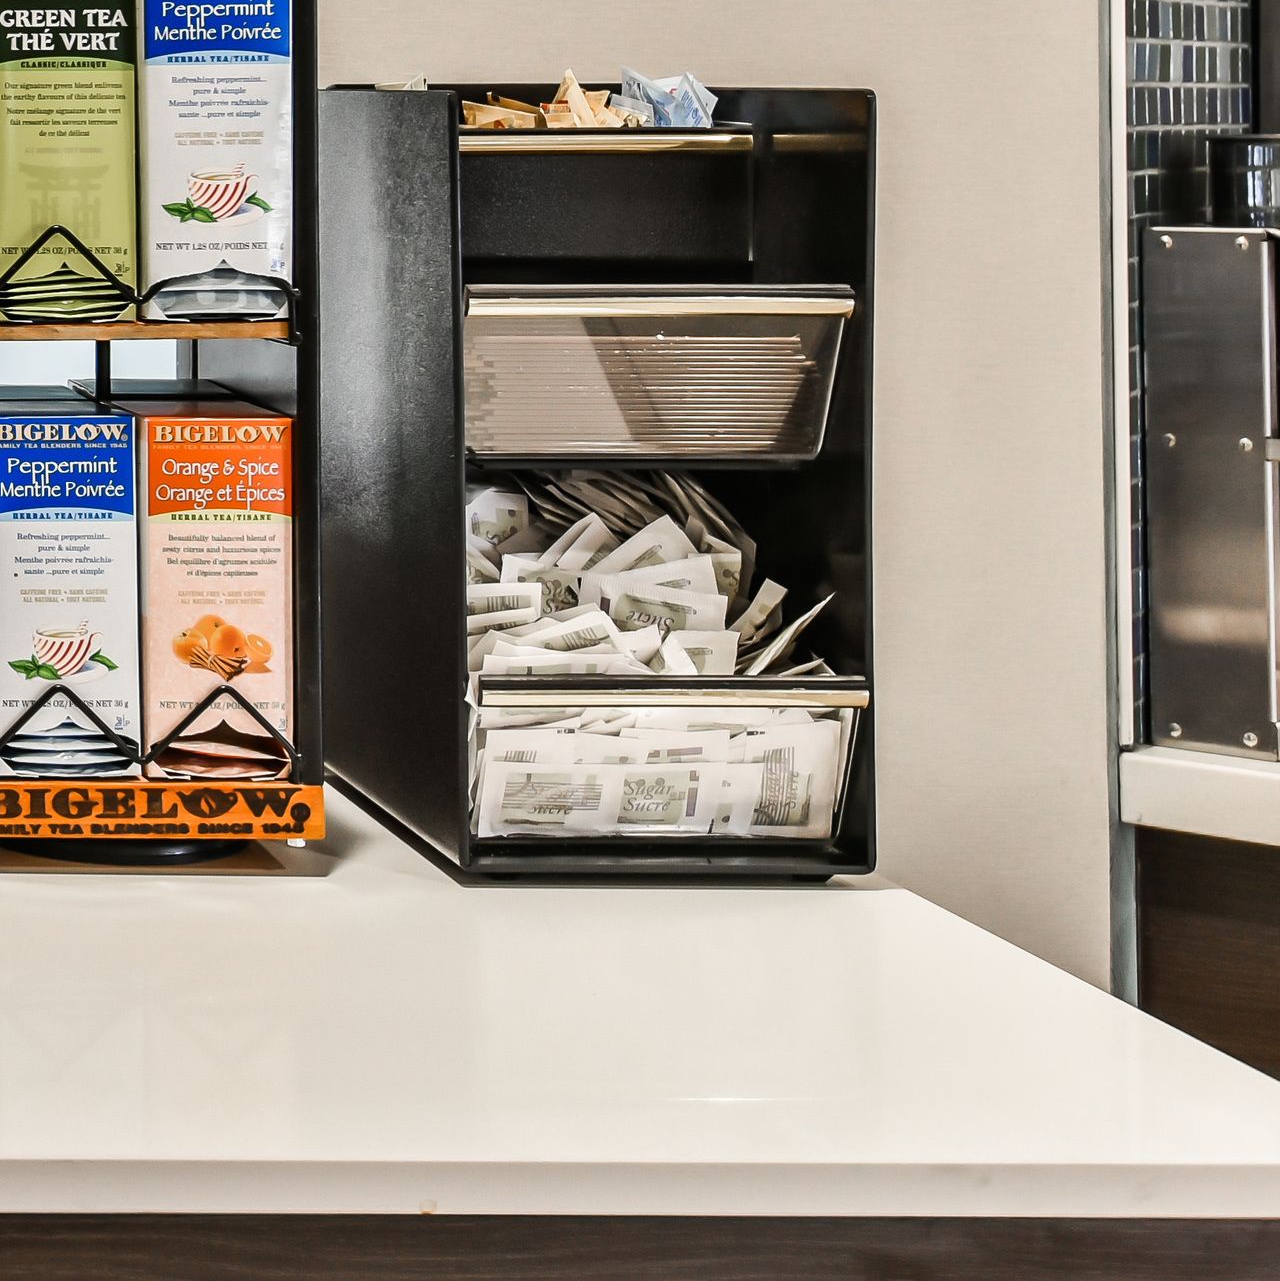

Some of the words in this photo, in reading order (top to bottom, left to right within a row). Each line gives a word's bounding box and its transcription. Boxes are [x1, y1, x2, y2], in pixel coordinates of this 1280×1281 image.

[0, 9, 75, 27] GREEN
[82, 9, 128, 27] TEA
[154, 18, 217, 41] Menthe
[221, 22, 281, 40] Poivrée
[6, 28, 55, 50] THÉ
[59, 32, 120, 50] VERT
[21, 61, 107, 69] CLASSIC/CLASSIQUE
[167, 55, 206, 63] HERBAL
[210, 55, 269, 63] TEA/TISANE
[1, 247, 19, 255] NET
[95, 247, 112, 255] NET
[156, 242, 173, 251] NET
[176, 242, 190, 251] WT
[253, 242, 267, 251] NET
[153, 426, 288, 443] BIGELOW
[8, 456, 117, 484] Peppermint
[162, 459, 219, 484] Orange
[223, 460, 234, 476] &
[238, 457, 279, 486] Spice
[0, 474, 61, 497] Menthe
[66, 480, 125, 497] Poivrée
[156, 485, 213, 510] Orange
[217, 485, 232, 501] et
[236, 480, 285, 510] Épices
[17, 533, 59, 541] Refreshing
[15, 556, 44, 564] Menthe
[2, 700, 19, 708] NET
[95, 700, 113, 708] NET
[124, 700, 129, 708] g
[159, 701, 177, 710] NET
[180, 701, 194, 710] WT
[253, 701, 269, 710] NET
[623, 782, 675, 802] Sugar
[623, 796, 670, 813] Sucre
[49, 824, 83, 835] TEA
[91, 824, 190, 835] BLENDERS
[197, 824, 253, 835] SINCE
